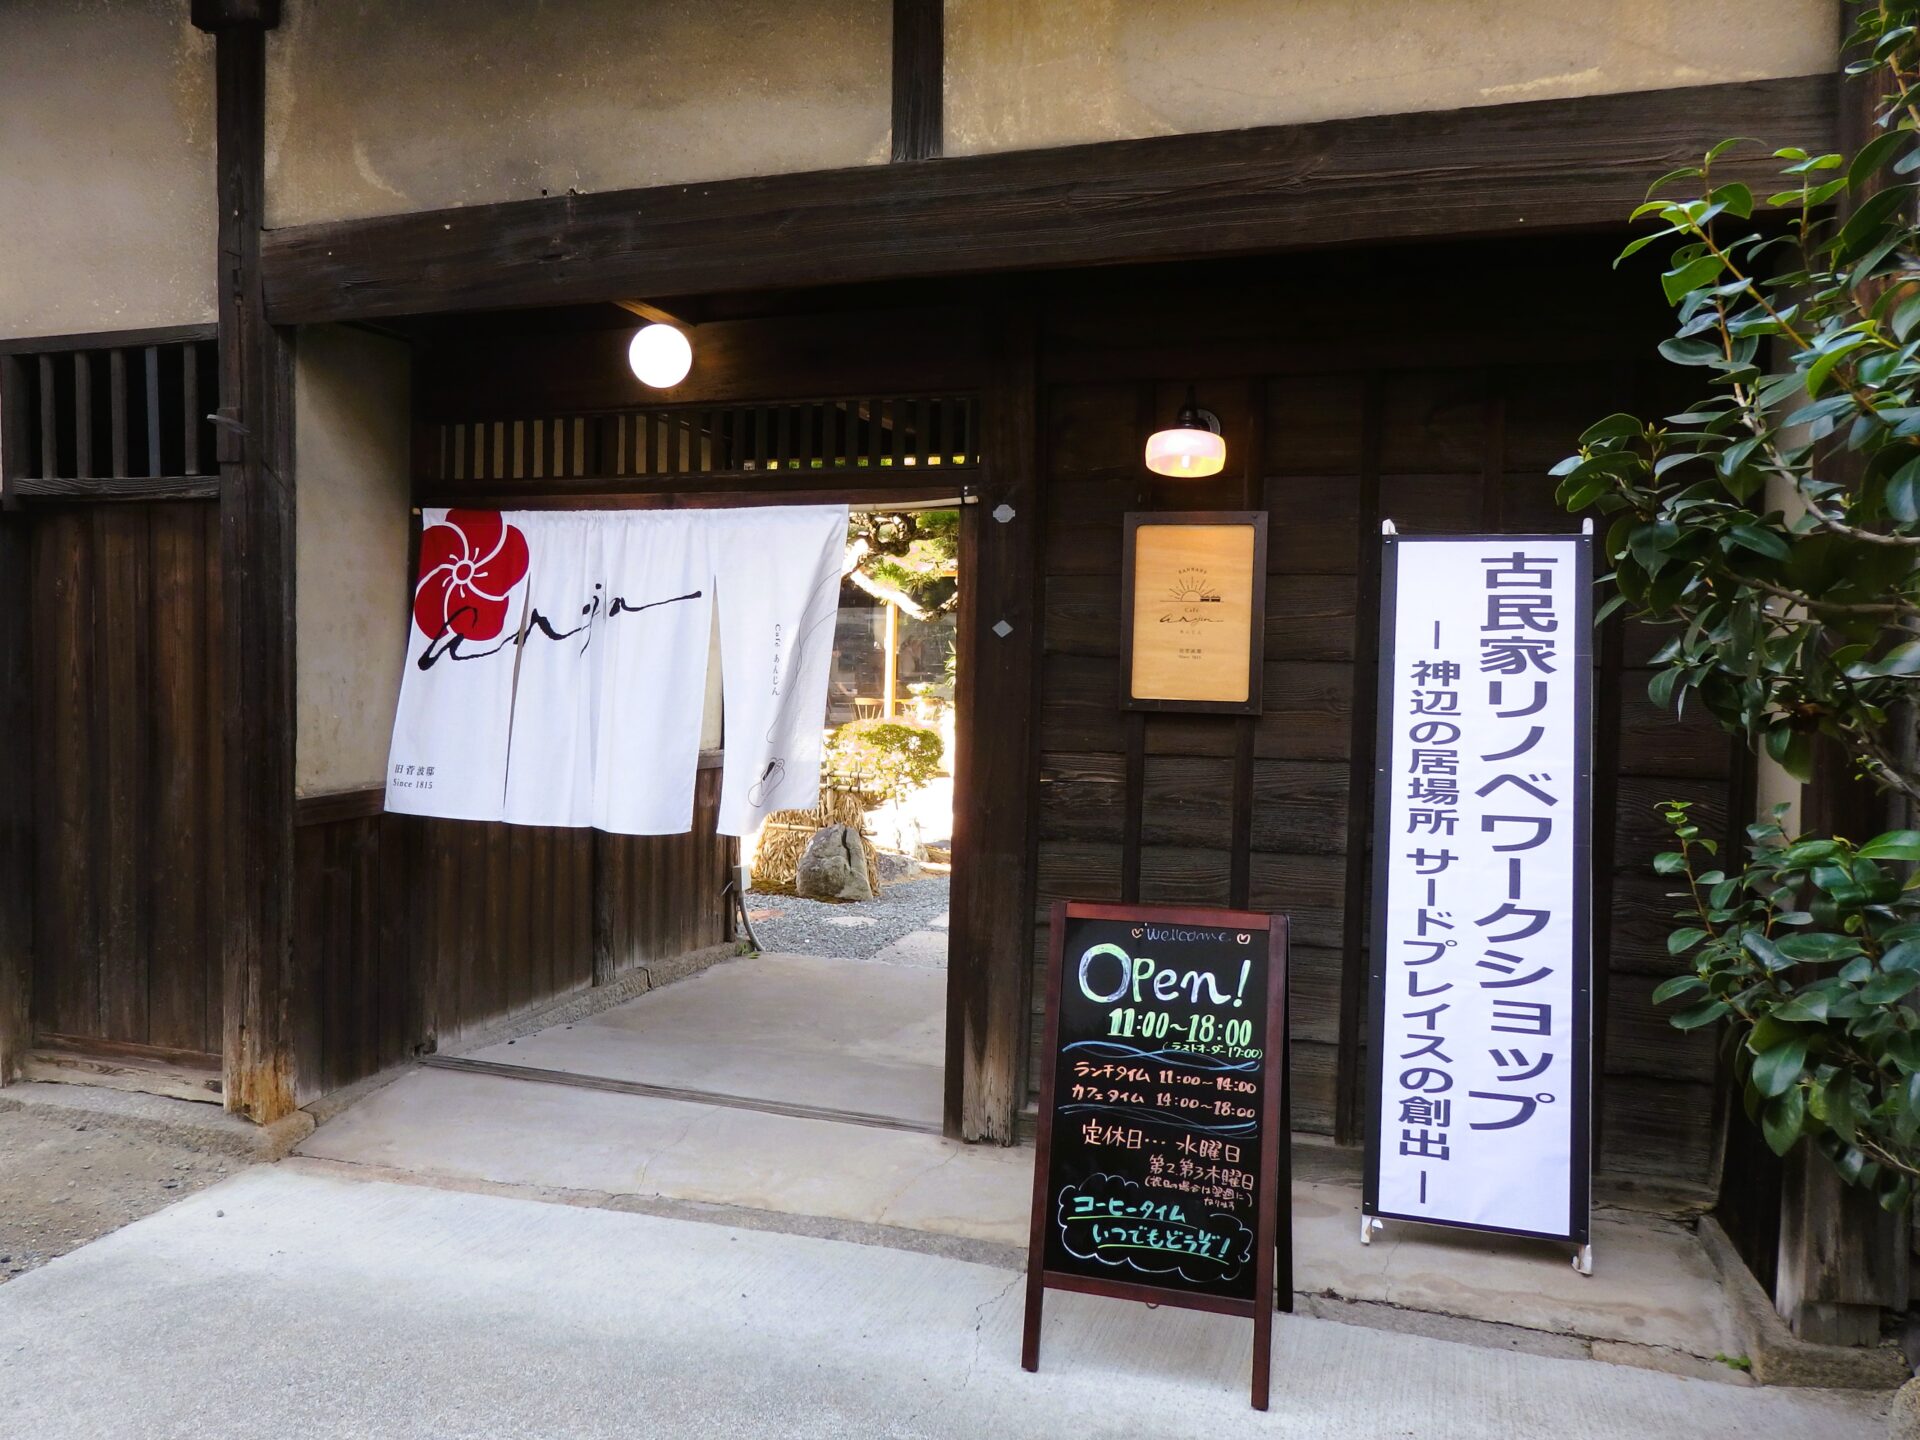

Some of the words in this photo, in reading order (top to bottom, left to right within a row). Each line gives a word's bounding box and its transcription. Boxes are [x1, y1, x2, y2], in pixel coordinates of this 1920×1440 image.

[392, 778, 413, 788] Since
[415, 780, 433, 789] 1815
[1468, 551, 1559, 1131] 古民家リノベワークショップ
[1073, 1061, 1151, 1084] ランチタイム
[1071, 1083, 1145, 1104] カフェタイム
[1175, 1134, 1241, 1163] 水曜日
[1073, 1196, 1186, 1224] コーヒータイム
